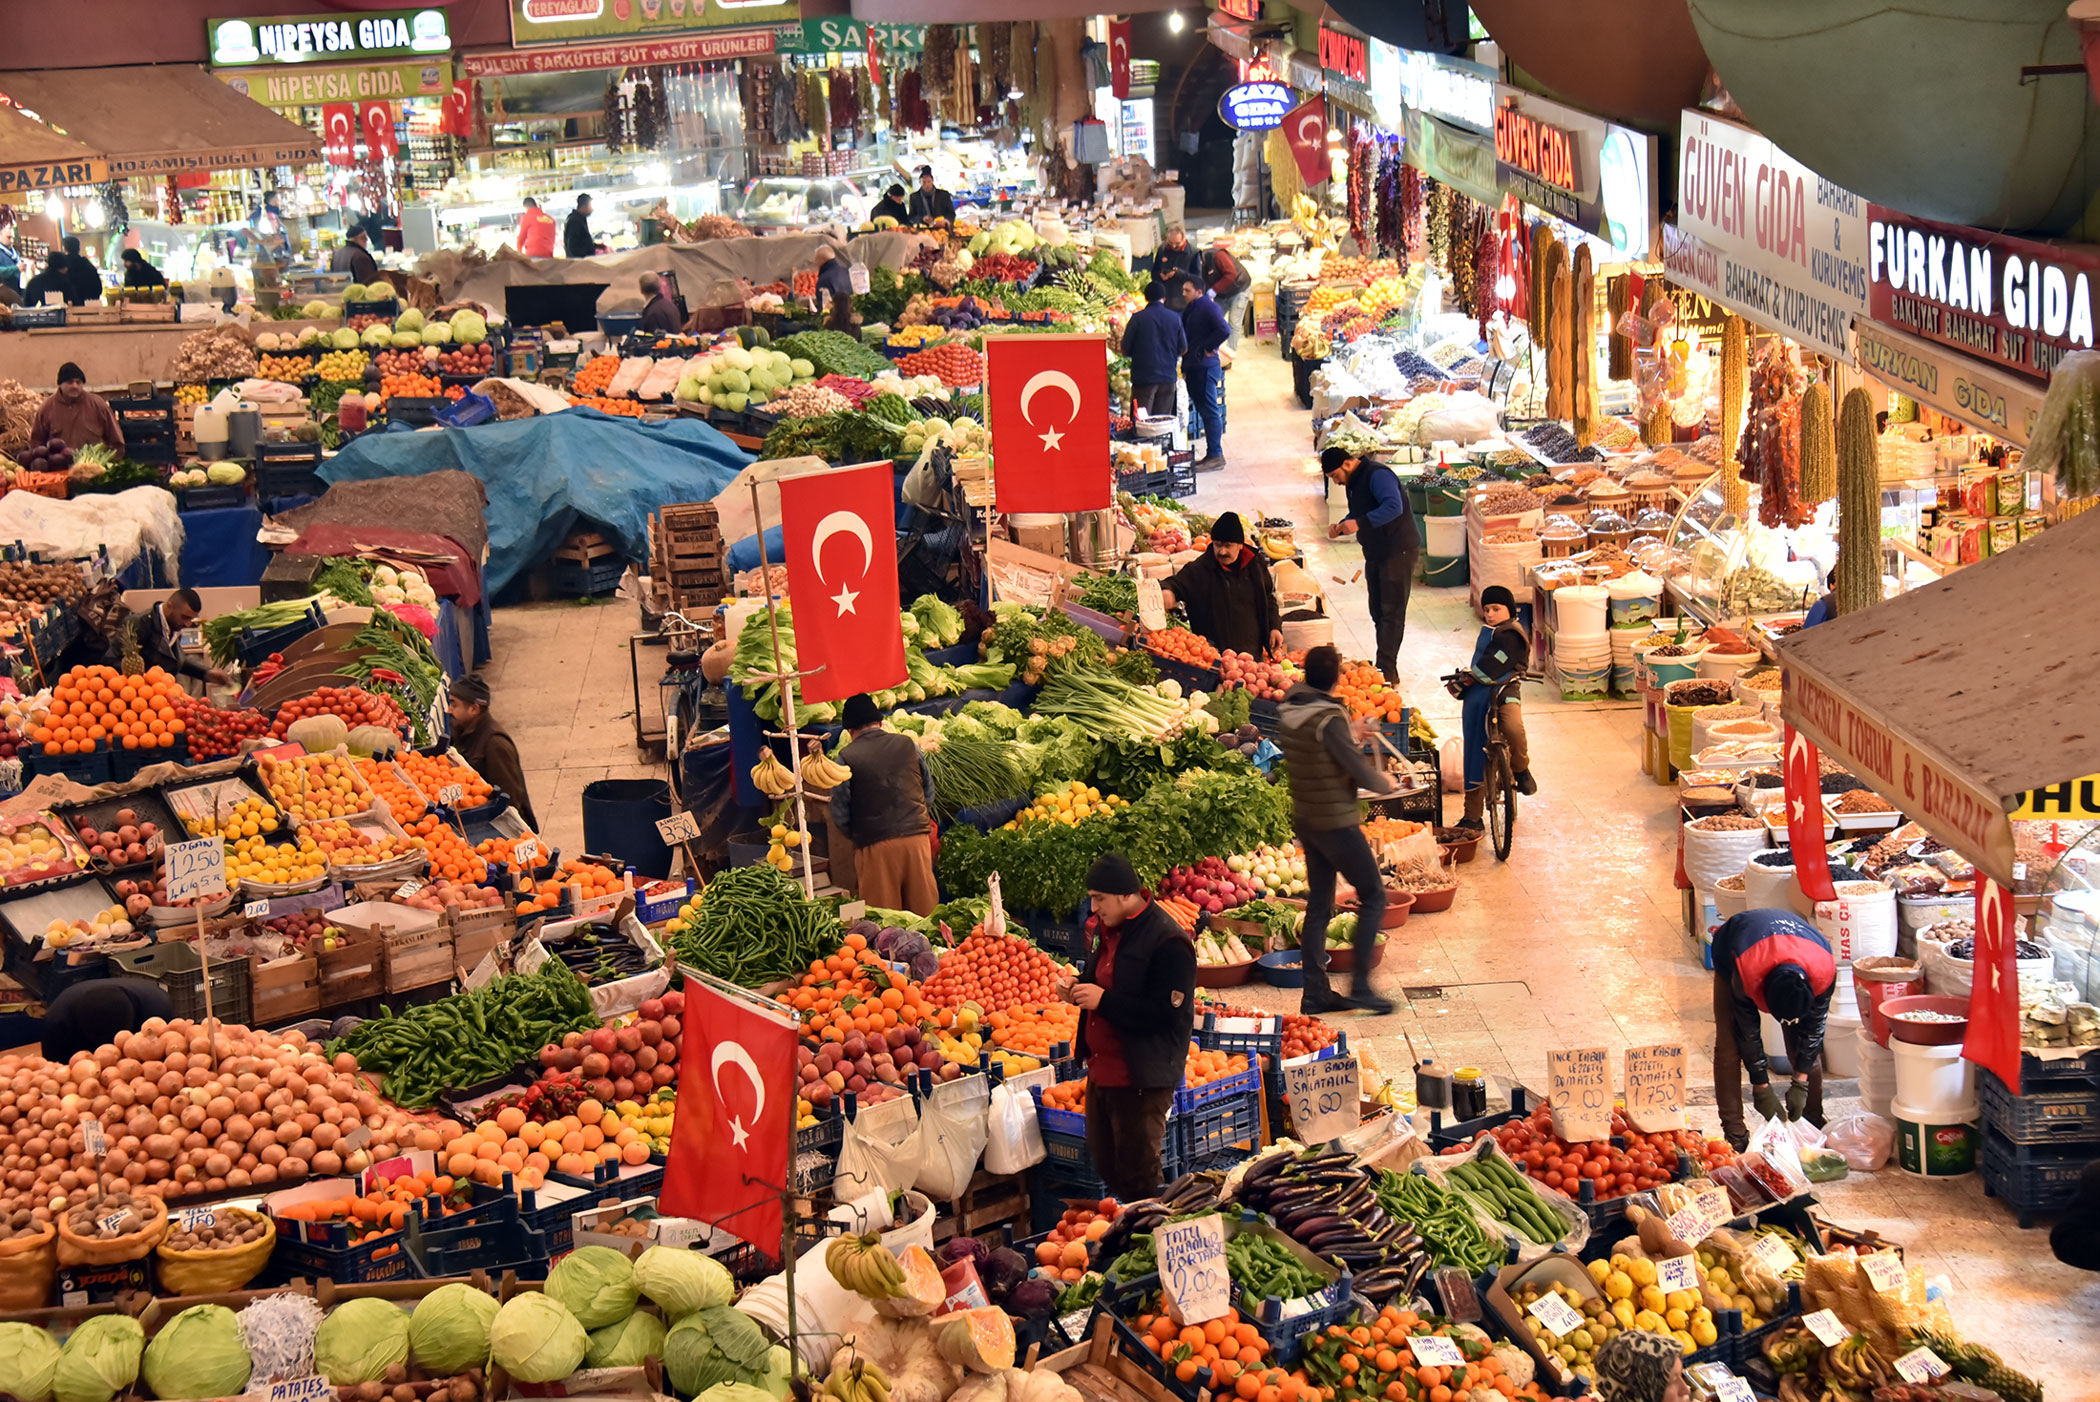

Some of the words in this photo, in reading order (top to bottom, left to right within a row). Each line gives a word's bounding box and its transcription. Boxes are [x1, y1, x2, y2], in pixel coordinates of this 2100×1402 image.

[358, 18, 410, 49] GIDA
[357, 70, 404, 96] GIDA
[275, 148, 319, 161] GIDA
[1495, 96, 1538, 176] GÜVEN
[1539, 123, 1575, 192] GIDA
[0, 162, 93, 191] PAZARI
[1684, 119, 1747, 240] GÜVEN
[1755, 163, 1807, 268] GIDA
[1834, 217, 1841, 252] &
[1812, 247, 1866, 309] KURUYEMİŞ
[1870, 221, 1992, 317] FURKAN
[2003, 254, 2094, 348] GIDA
[1697, 248, 1718, 292] GIDA
[1725, 260, 1773, 315] BAHARAT
[1773, 281, 1781, 320] &
[1783, 286, 1847, 356] KURUYEMİŞ
[1945, 311, 1997, 354] BAHARAT
[1860, 337, 1939, 395] FURKAN
[1953, 377, 2008, 430] GIDA
[1847, 710, 1894, 786] TOHUM
[1903, 752, 1915, 801] &
[1922, 763, 1994, 851] BAHARAT
[1840, 928, 1851, 960] HAS
[1554, 1073, 1604, 1088] DOMATES
[1630, 1067, 1683, 1087] DOMATES
[271, 1377, 323, 1402] PATATES
